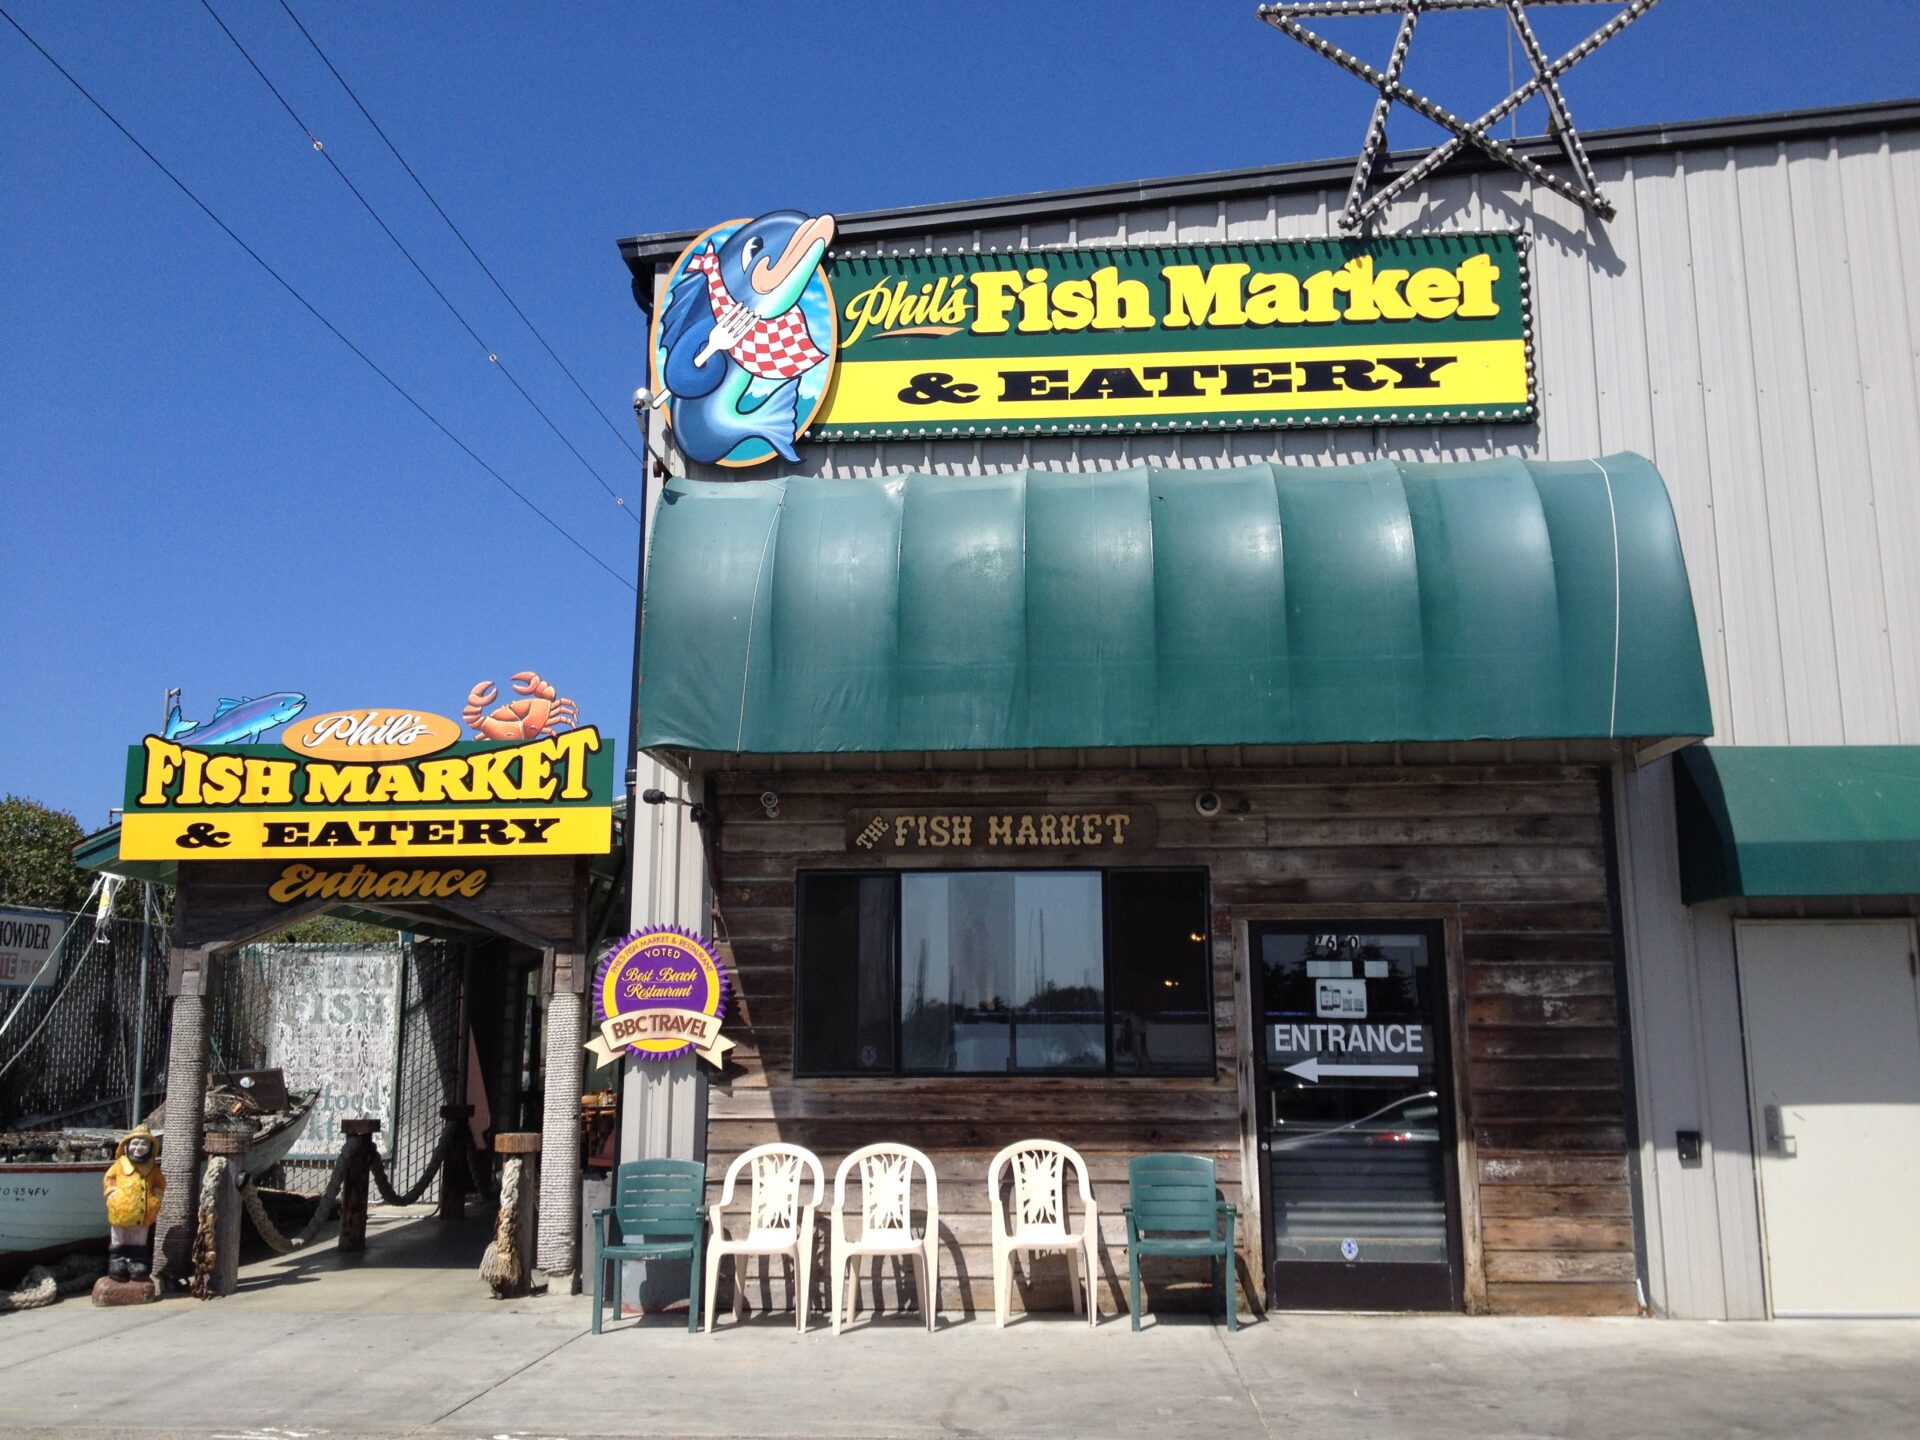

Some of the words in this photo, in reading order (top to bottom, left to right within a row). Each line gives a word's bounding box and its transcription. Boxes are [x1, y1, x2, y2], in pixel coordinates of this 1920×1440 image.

[840, 275, 974, 348] Phil's
[969, 264, 1154, 333] Fish
[1161, 253, 1500, 328] Market
[897, 371, 981, 404] &
[997, 356, 1458, 402] EATERY
[303, 711, 438, 750] Phil's
[138, 735, 295, 806] FISH
[302, 725, 600, 804] MARKET
[176, 822, 233, 848] &
[262, 818, 561, 848] EATERY
[855, 815, 890, 849] THE
[894, 815, 972, 847] FISH
[988, 814, 1131, 846] MARKET
[269, 864, 488, 901] Entrance
[641, 936, 669, 947] MARKET
[679, 939, 714, 972] RESTAURANT
[644, 948, 681, 959] VOTED
[622, 967, 653, 982] Best
[656, 967, 698, 982] Beach
[624, 984, 693, 1000] Restaurant
[612, 1016, 648, 1041] BBC
[649, 1014, 706, 1039] TRAVEL
[1274, 1024, 1423, 1053] ENTRANCE
